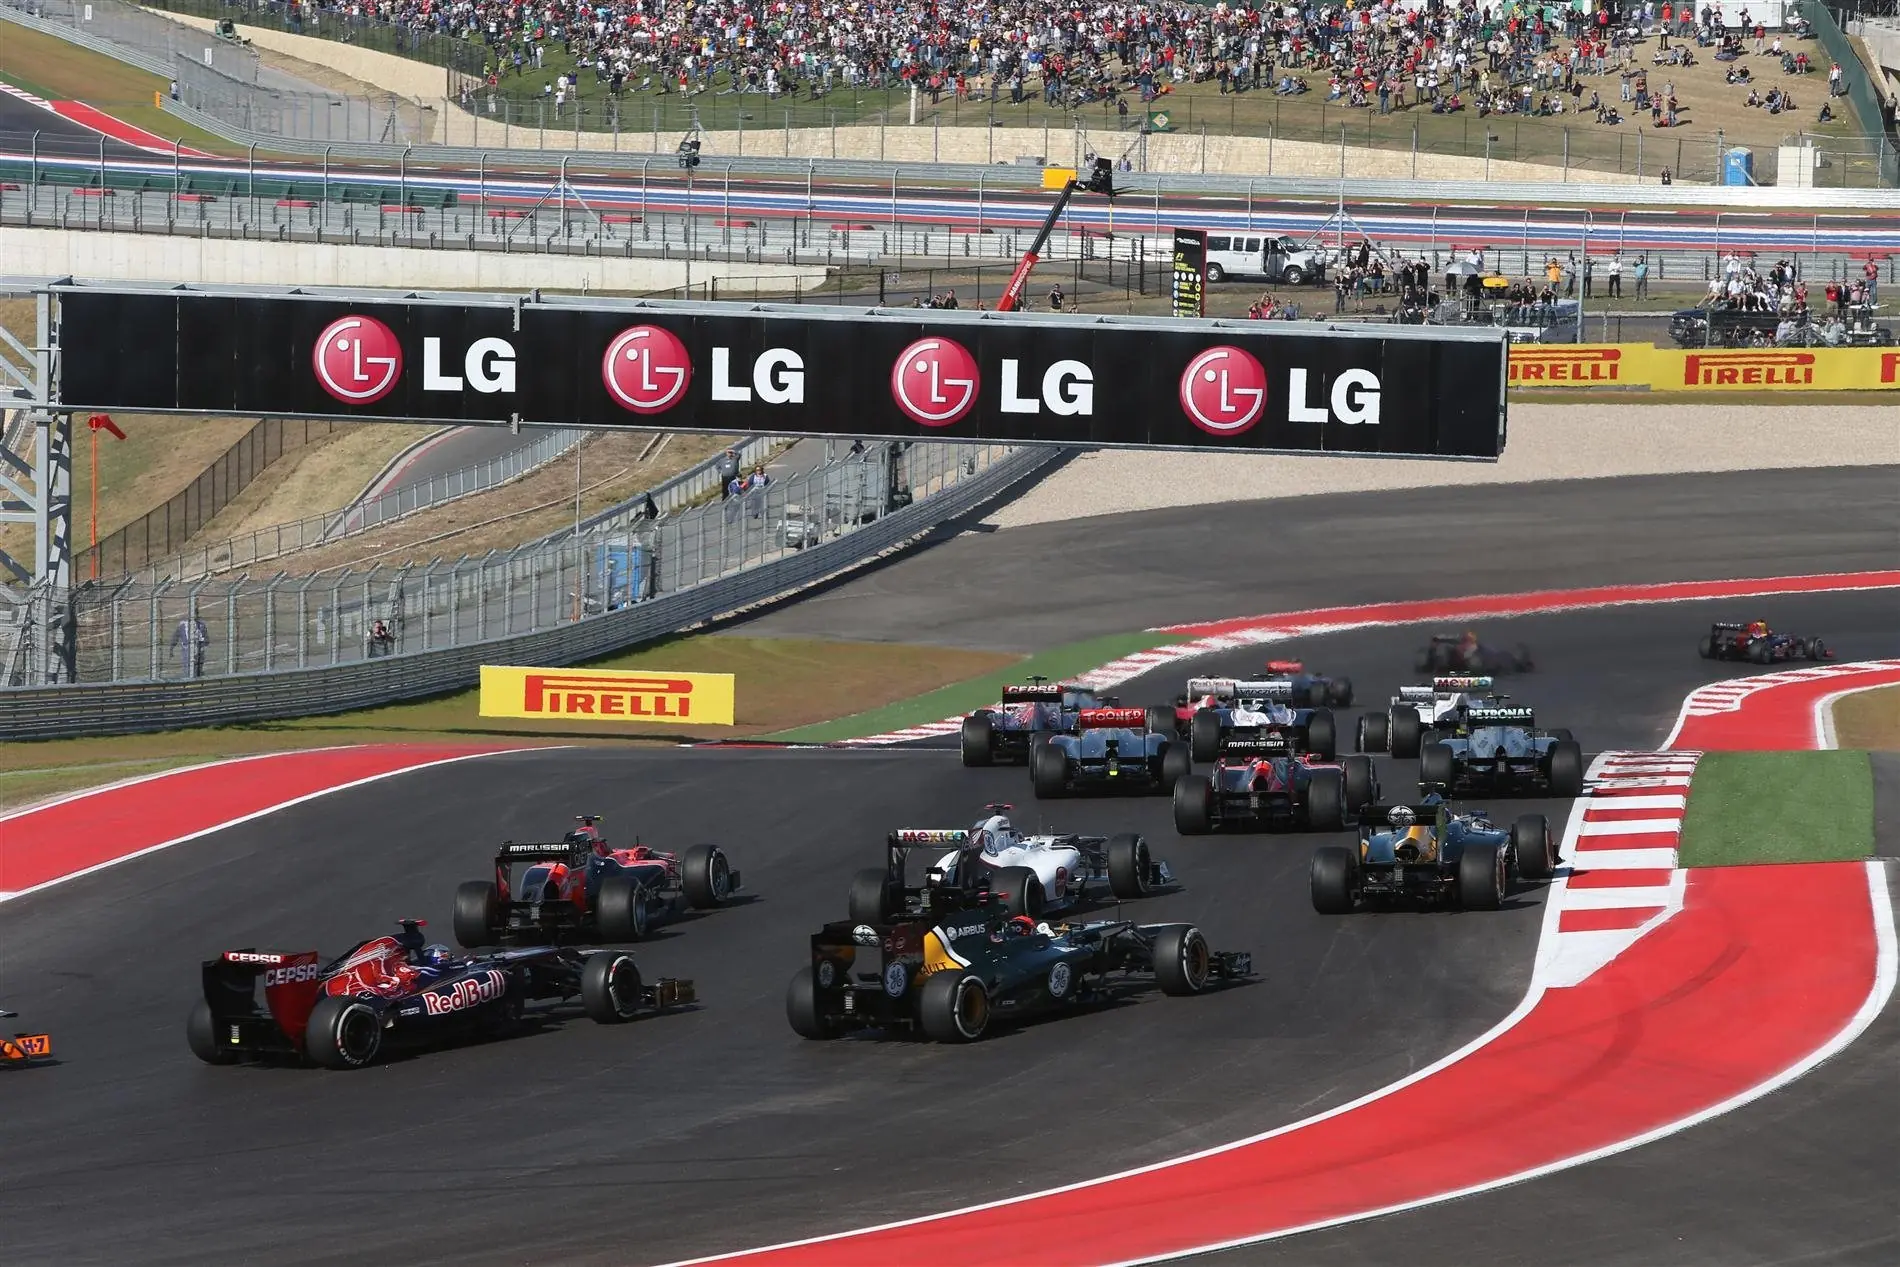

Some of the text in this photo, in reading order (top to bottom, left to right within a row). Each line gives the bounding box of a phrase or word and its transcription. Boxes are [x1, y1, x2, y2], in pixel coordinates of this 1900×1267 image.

[1684, 352, 1815, 385] PIRELLI
[423, 337, 516, 393] LG
[711, 347, 804, 404] LG
[1000, 359, 1093, 416] LG
[1288, 368, 1380, 425] LG
[524, 675, 693, 717] PIRELLI
[1469, 707, 1532, 719] PETRONAS
[509, 844, 570, 852] MARUSSIA
[957, 924, 986, 937] AIRBUS
[228, 952, 282, 964] CEPSA
[265, 963, 317, 987] CEPSA
